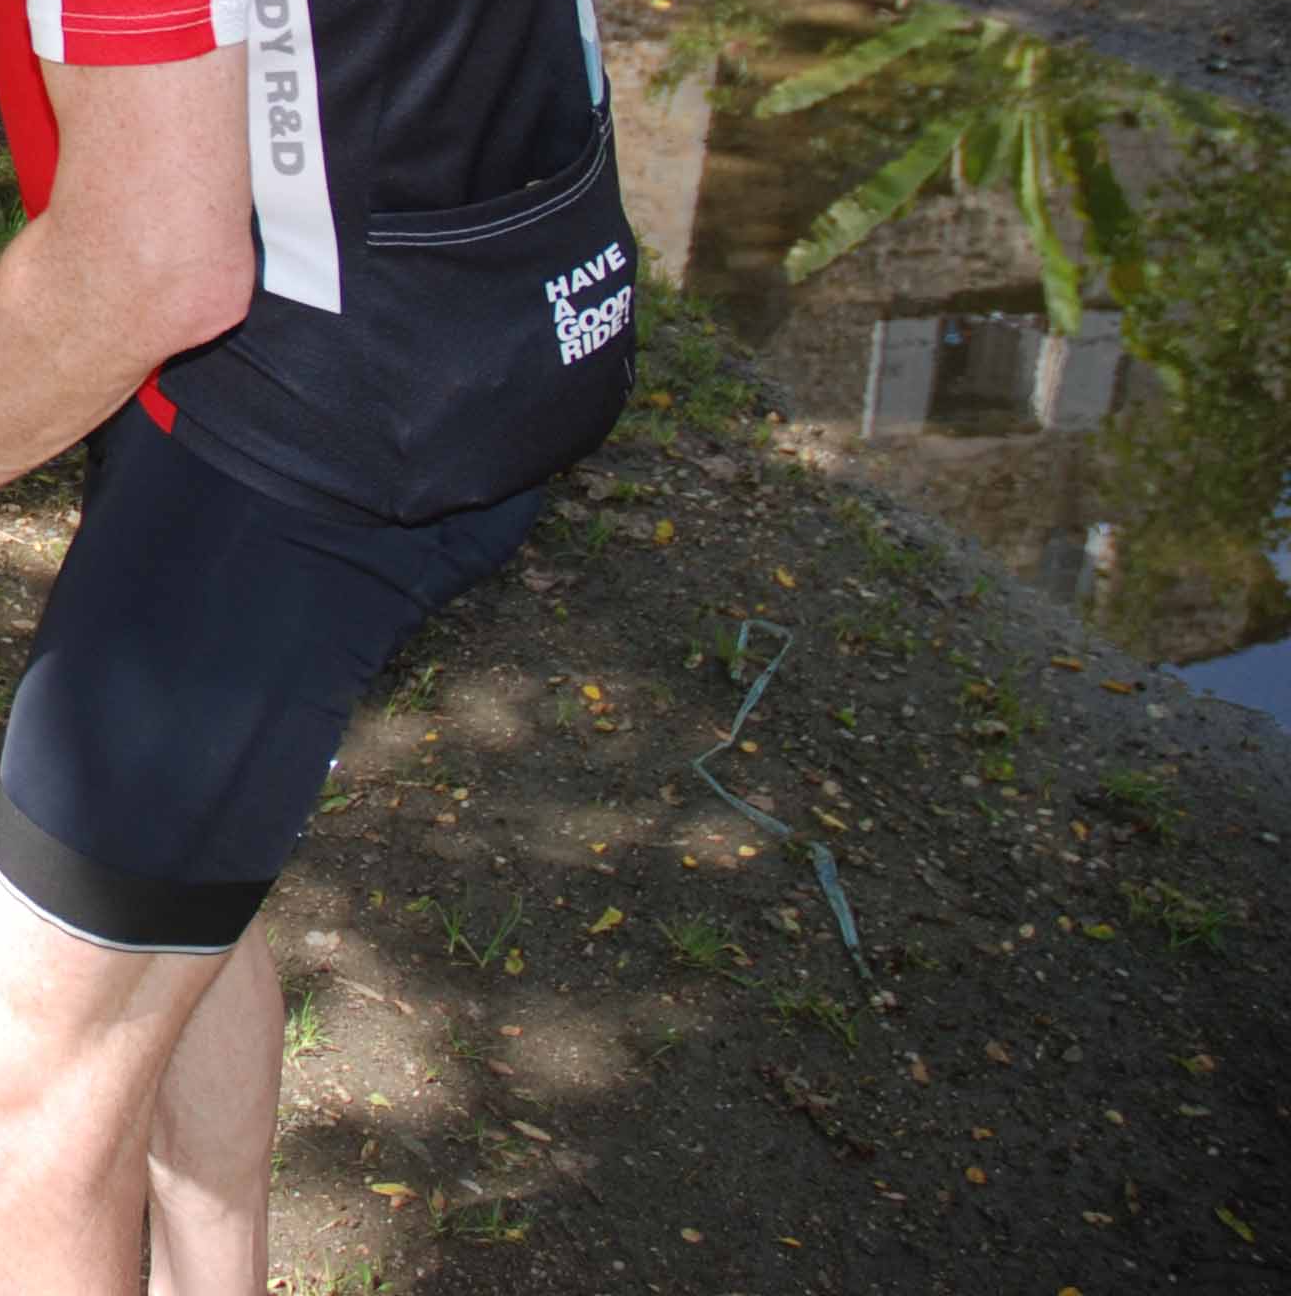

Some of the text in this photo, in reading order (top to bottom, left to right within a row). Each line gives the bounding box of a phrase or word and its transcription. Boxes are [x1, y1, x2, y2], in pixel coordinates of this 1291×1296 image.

[264, 70, 306, 177] R&D
[545, 242, 627, 303] HAVE
[553, 298, 577, 322] A
[556, 285, 632, 343] GOOD
[560, 304, 630, 365] RIDE!
